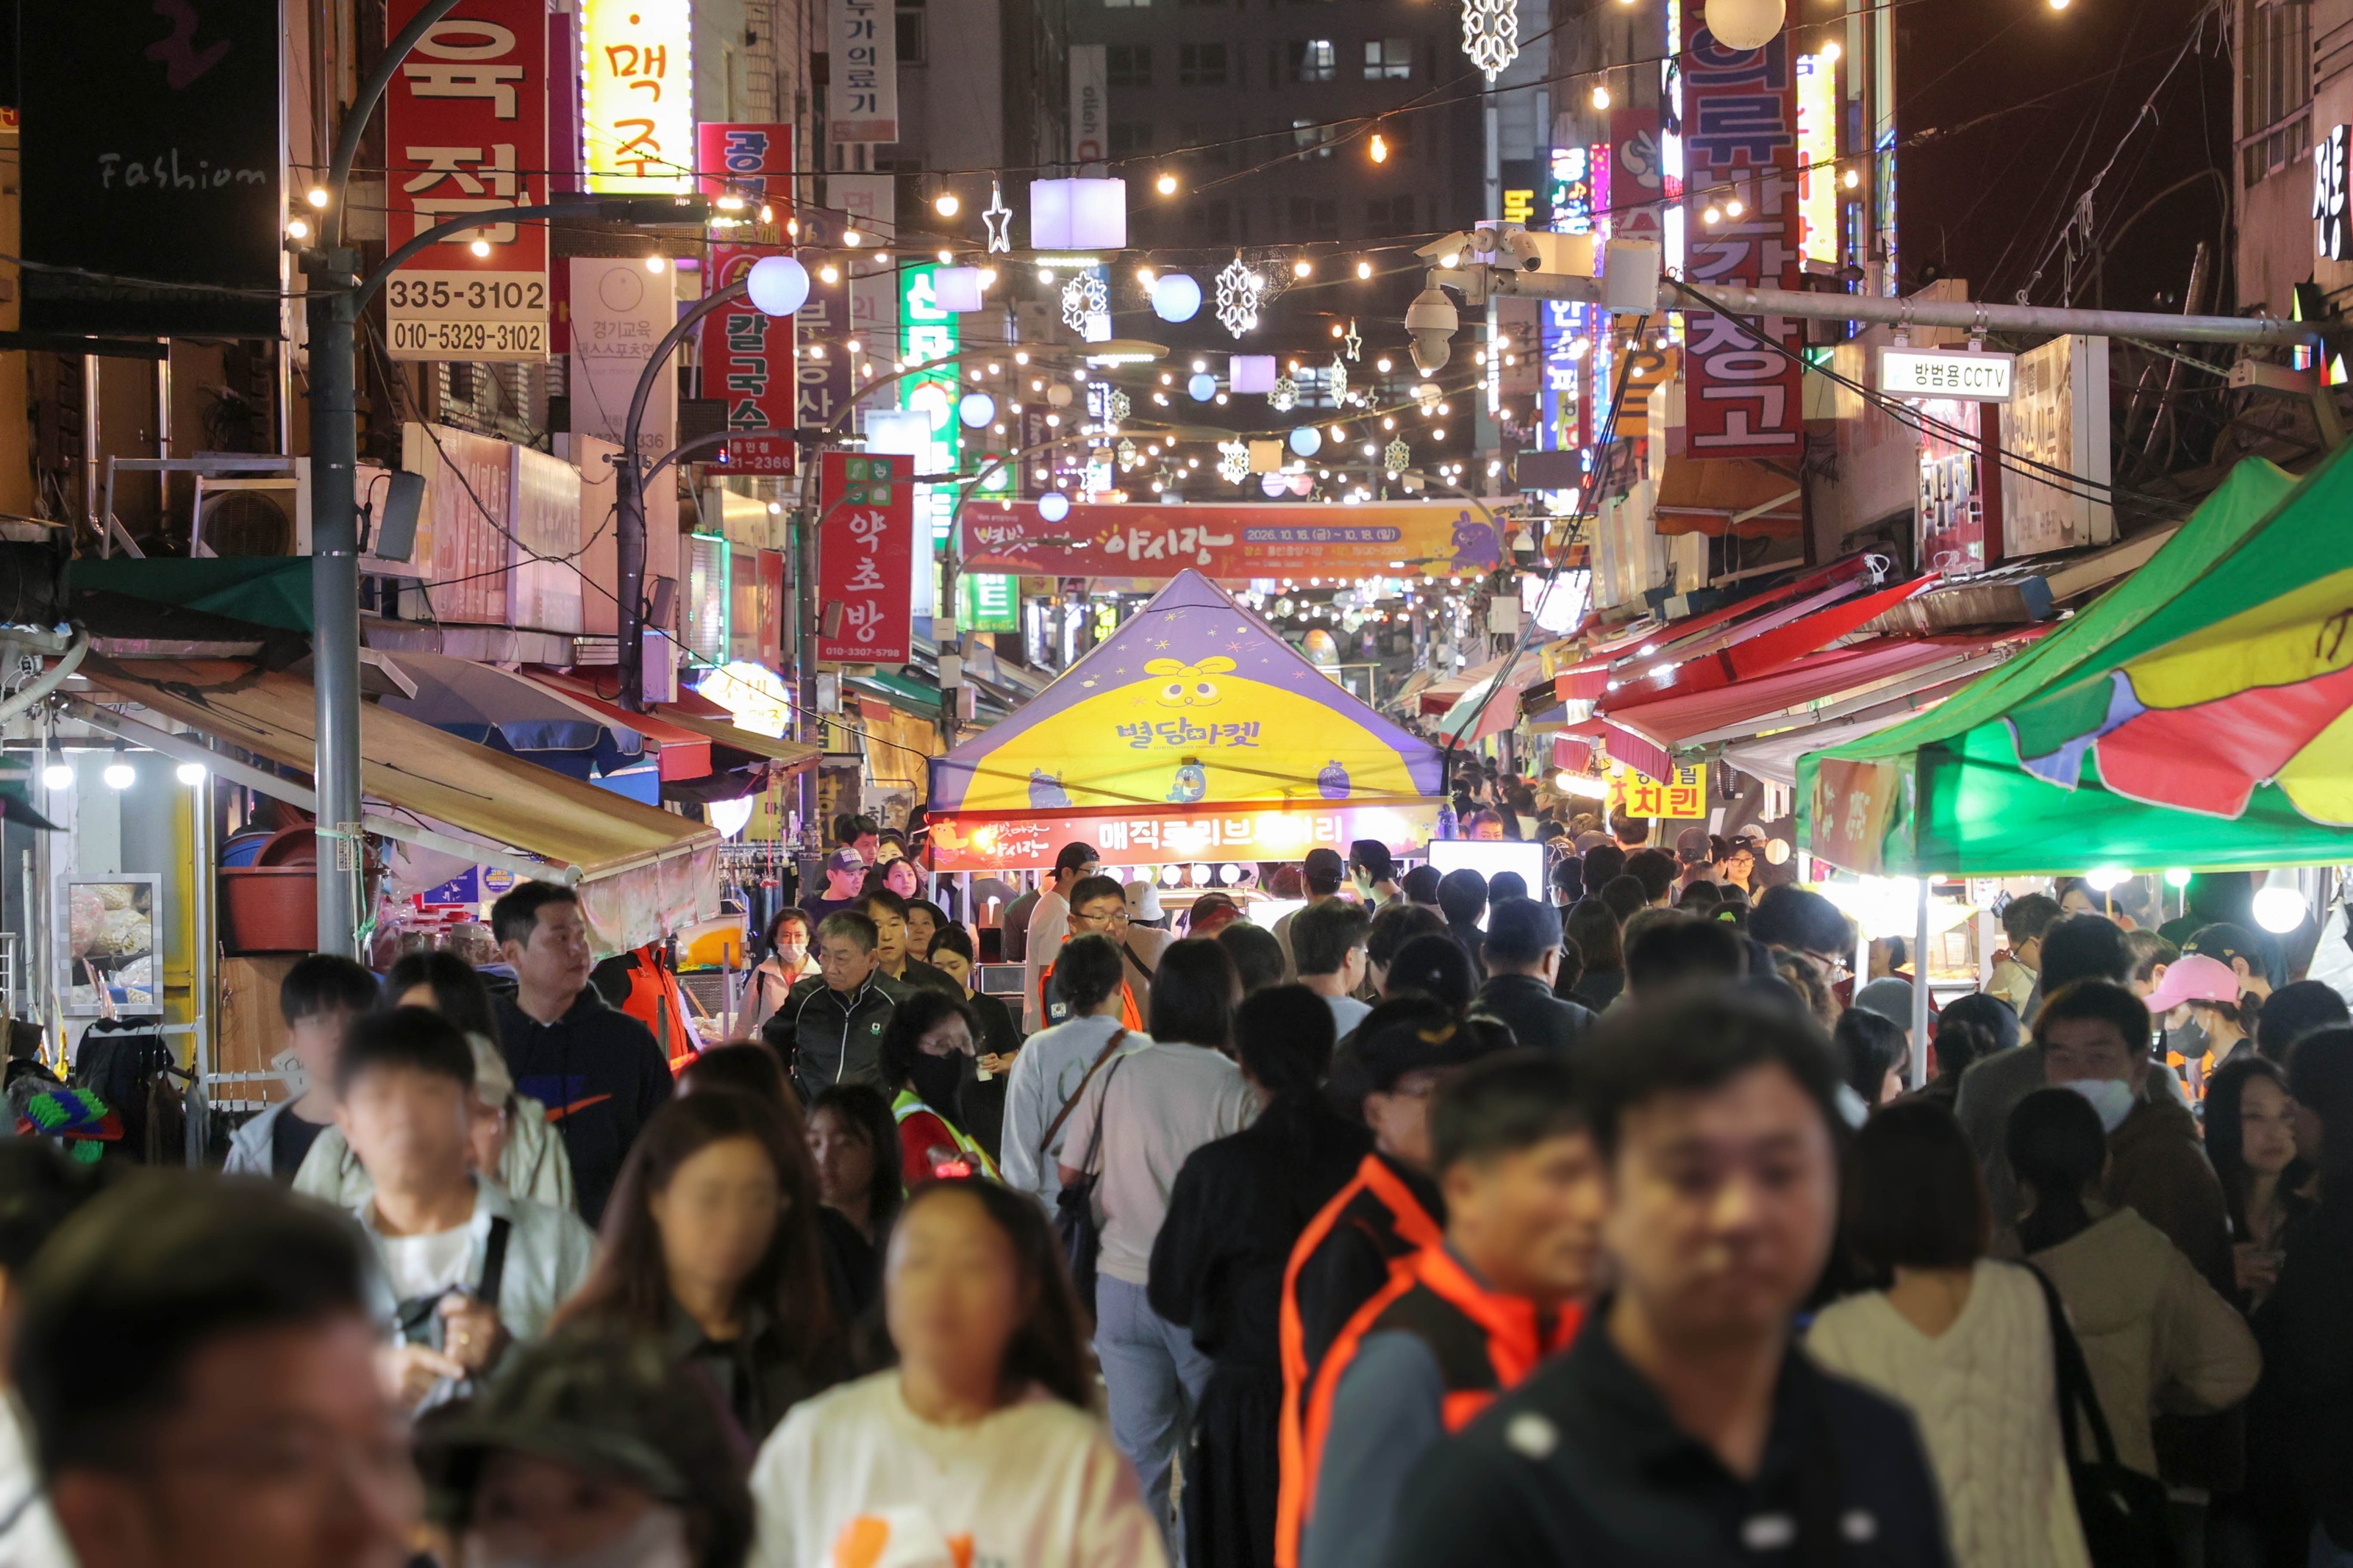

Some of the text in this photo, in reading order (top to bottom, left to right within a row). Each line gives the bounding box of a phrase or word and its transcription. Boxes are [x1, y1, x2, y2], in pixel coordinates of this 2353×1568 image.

[98, 148, 267, 190] Fashion
[390, 281, 544, 309] 335-3102
[395, 323, 540, 351] 010-5329-3102
[593, 321, 651, 339] 경기교육
[1104, 525, 1234, 565] 야시장
[845, 510, 887, 643] 약초방
[826, 647, 900, 658] 010-3307-5798
[1115, 717, 1260, 749] 별당마켓
[1633, 787, 1697, 815] 치킨
